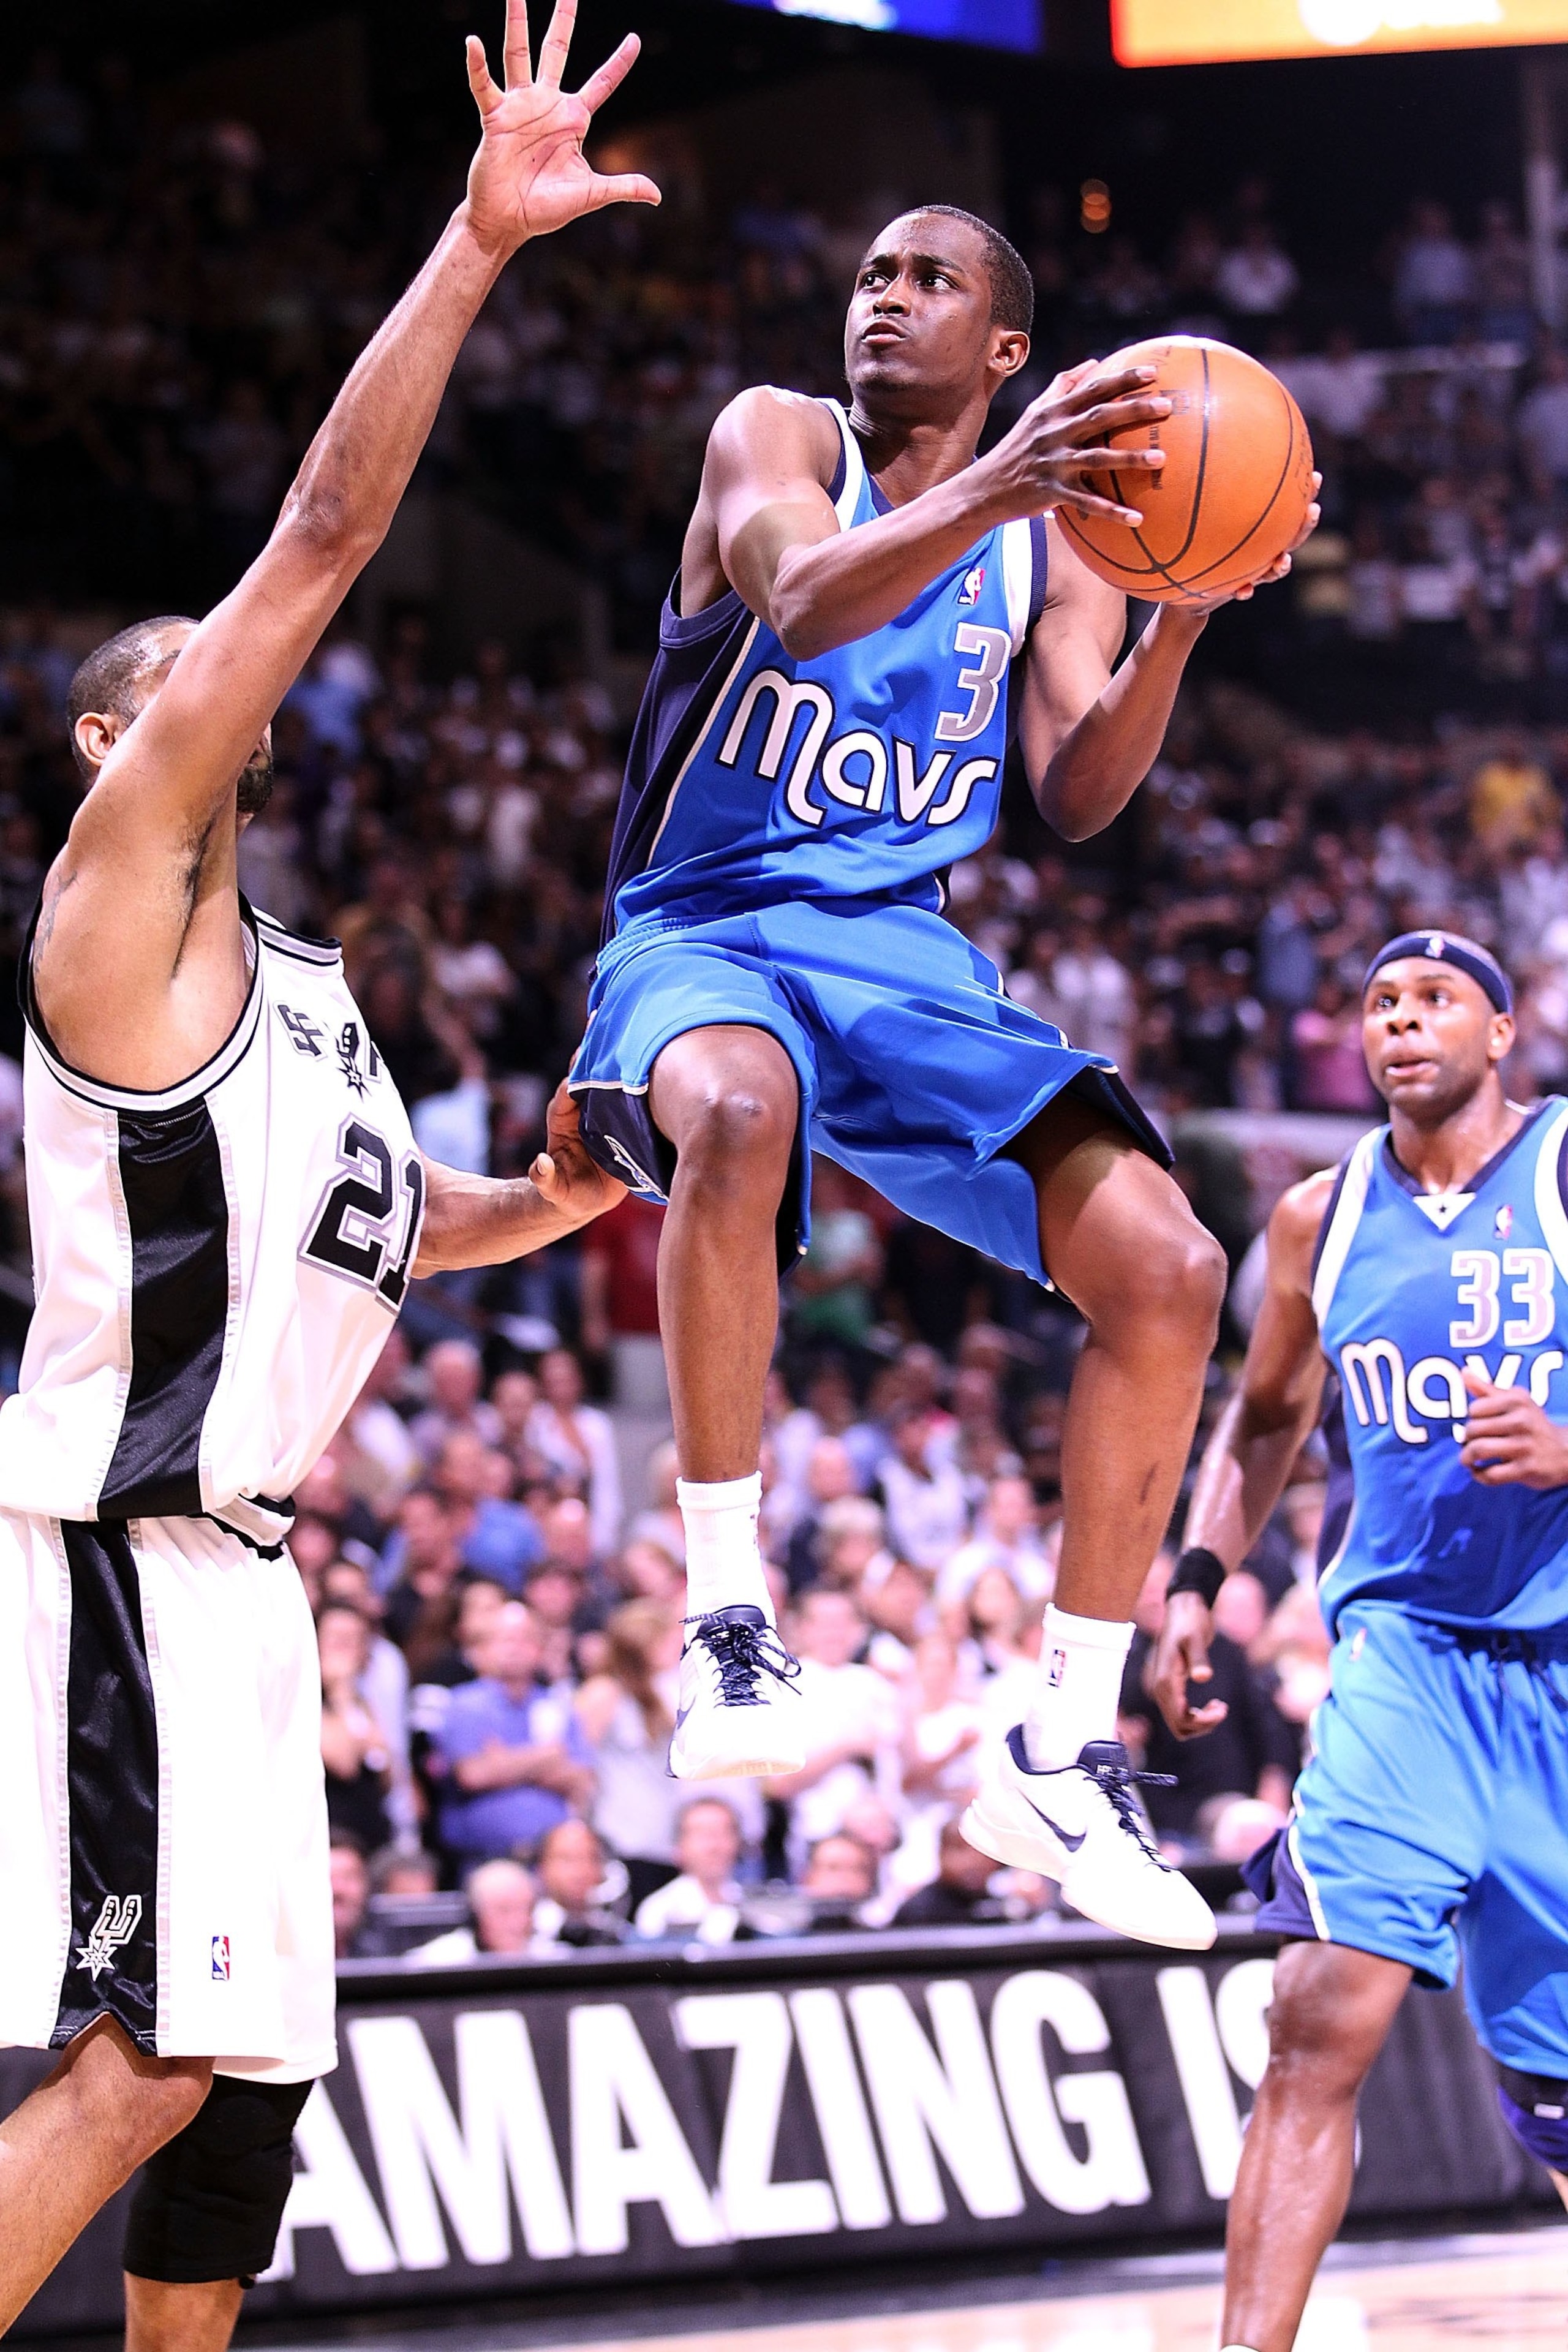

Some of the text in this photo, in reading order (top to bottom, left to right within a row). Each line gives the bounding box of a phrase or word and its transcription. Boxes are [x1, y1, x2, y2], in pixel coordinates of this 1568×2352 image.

[934, 622, 1012, 742] 3
[296, 1112, 426, 1318] 21
[1449, 1247, 1555, 1348] 33
[255, 1969, 1152, 2283] AMAZING
